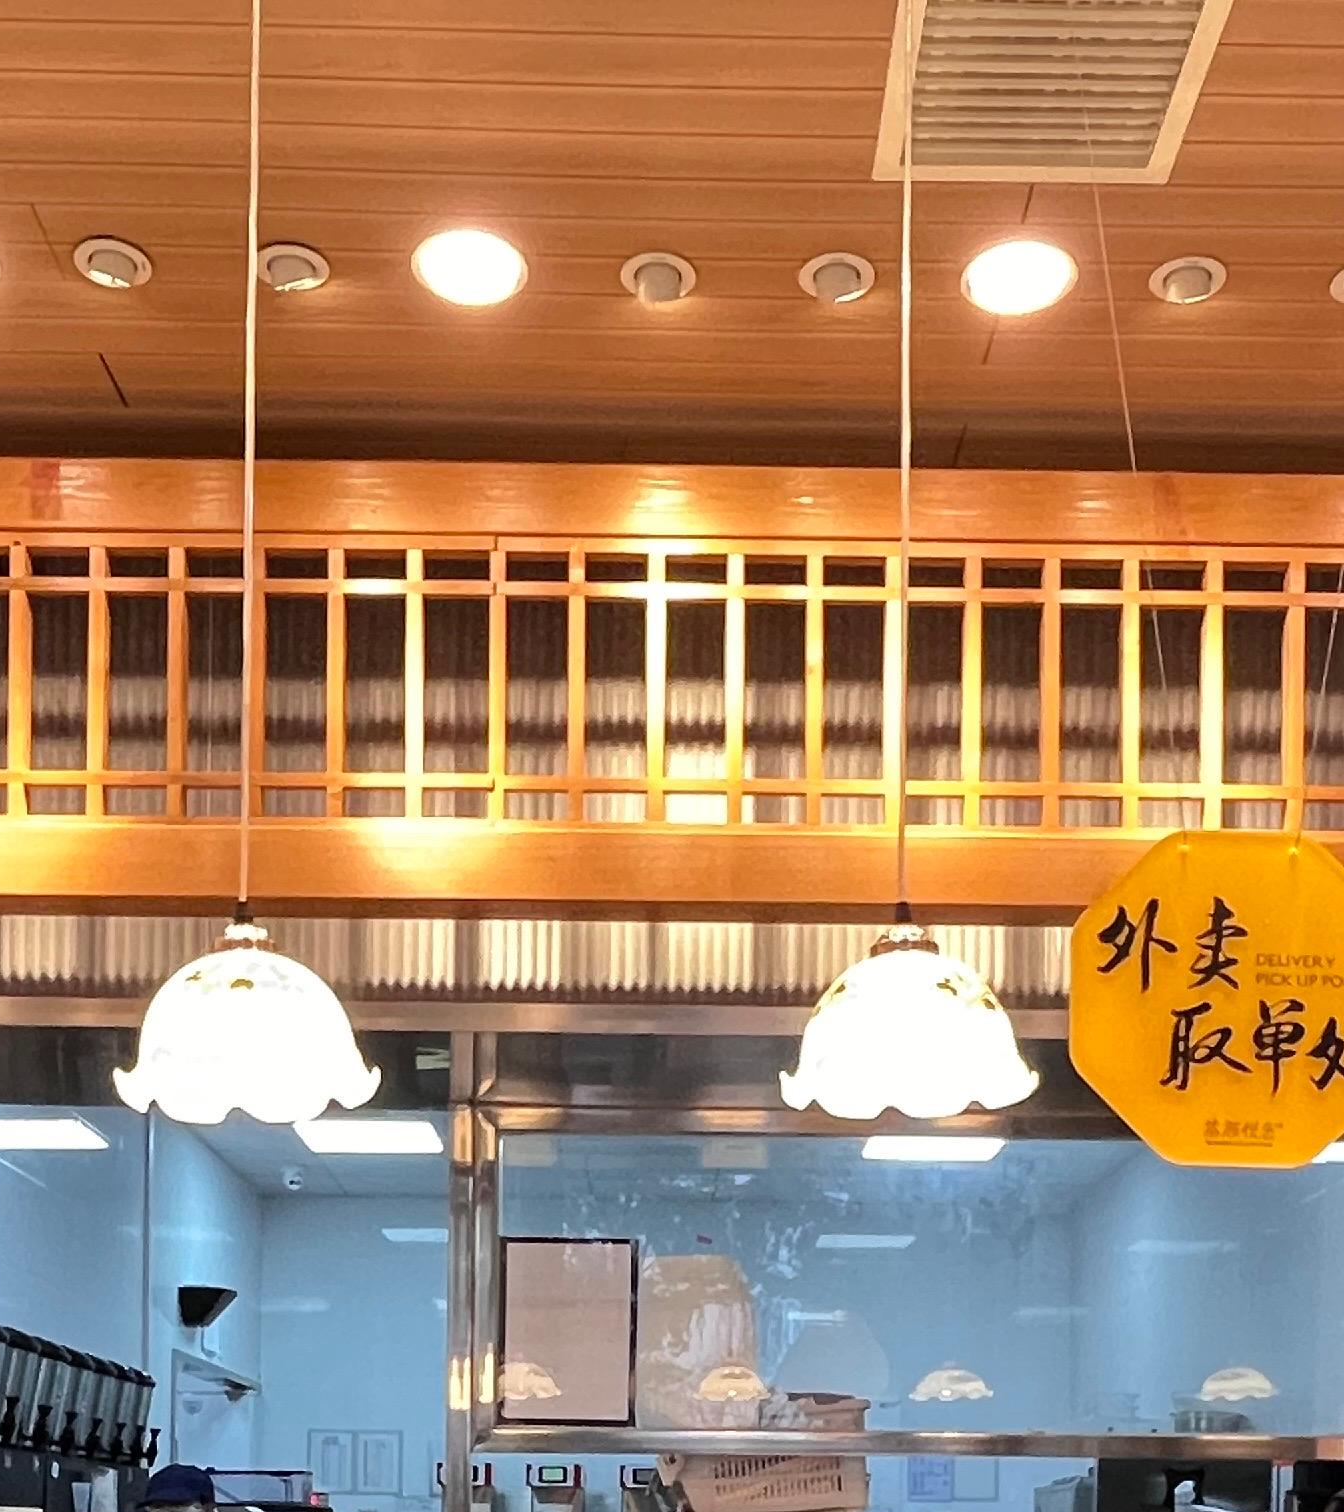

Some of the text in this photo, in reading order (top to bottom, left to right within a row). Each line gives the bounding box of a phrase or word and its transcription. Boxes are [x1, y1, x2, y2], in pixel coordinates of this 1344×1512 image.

[1096, 896, 1249, 994] 外卖
[1256, 953, 1336, 969] DELIVERY
[1256, 973, 1292, 987] PICK
[1297, 975, 1319, 987] UP
